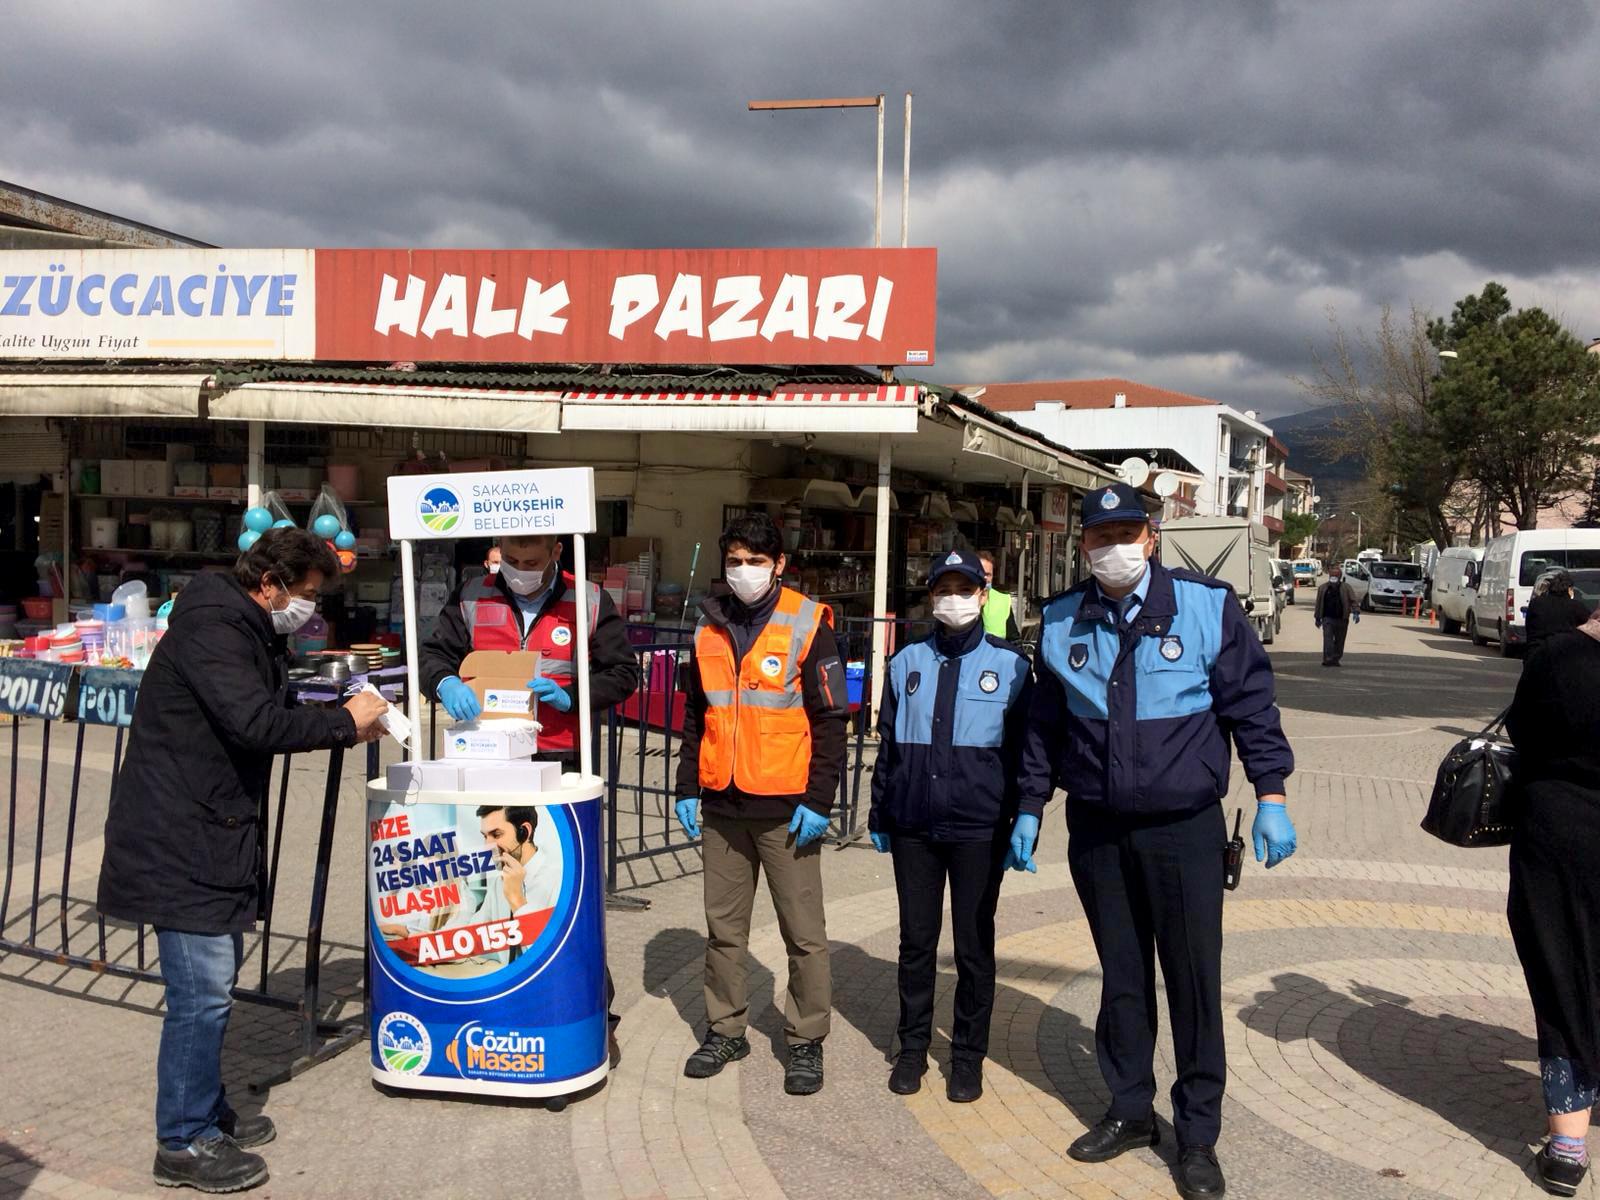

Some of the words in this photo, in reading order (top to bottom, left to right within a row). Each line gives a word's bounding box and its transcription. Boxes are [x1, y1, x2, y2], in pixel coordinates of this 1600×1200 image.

[0, 264, 298, 316] ZÜCCACİYE
[374, 272, 570, 341] HALK
[608, 272, 894, 342] PAZARI
[0, 334, 36, 347] alite
[41, 335, 91, 352] Uygun
[98, 335, 140, 352] Fiyat
[472, 482, 539, 497] SAKARYA
[473, 496, 564, 514] BÜYÜKŞEHİR
[474, 514, 555, 530] BELEDİYESİ
[78, 685, 139, 725] POL
[370, 815, 411, 842] BİZE
[373, 844, 395, 867] 24
[396, 831, 457, 863] SAAT
[376, 850, 497, 893] KESİNTİSİZ
[379, 884, 461, 918] ULAŞIN
[418, 934, 475, 963] ALO
[476, 920, 524, 951] 153
[467, 1046, 545, 1072] Masası
